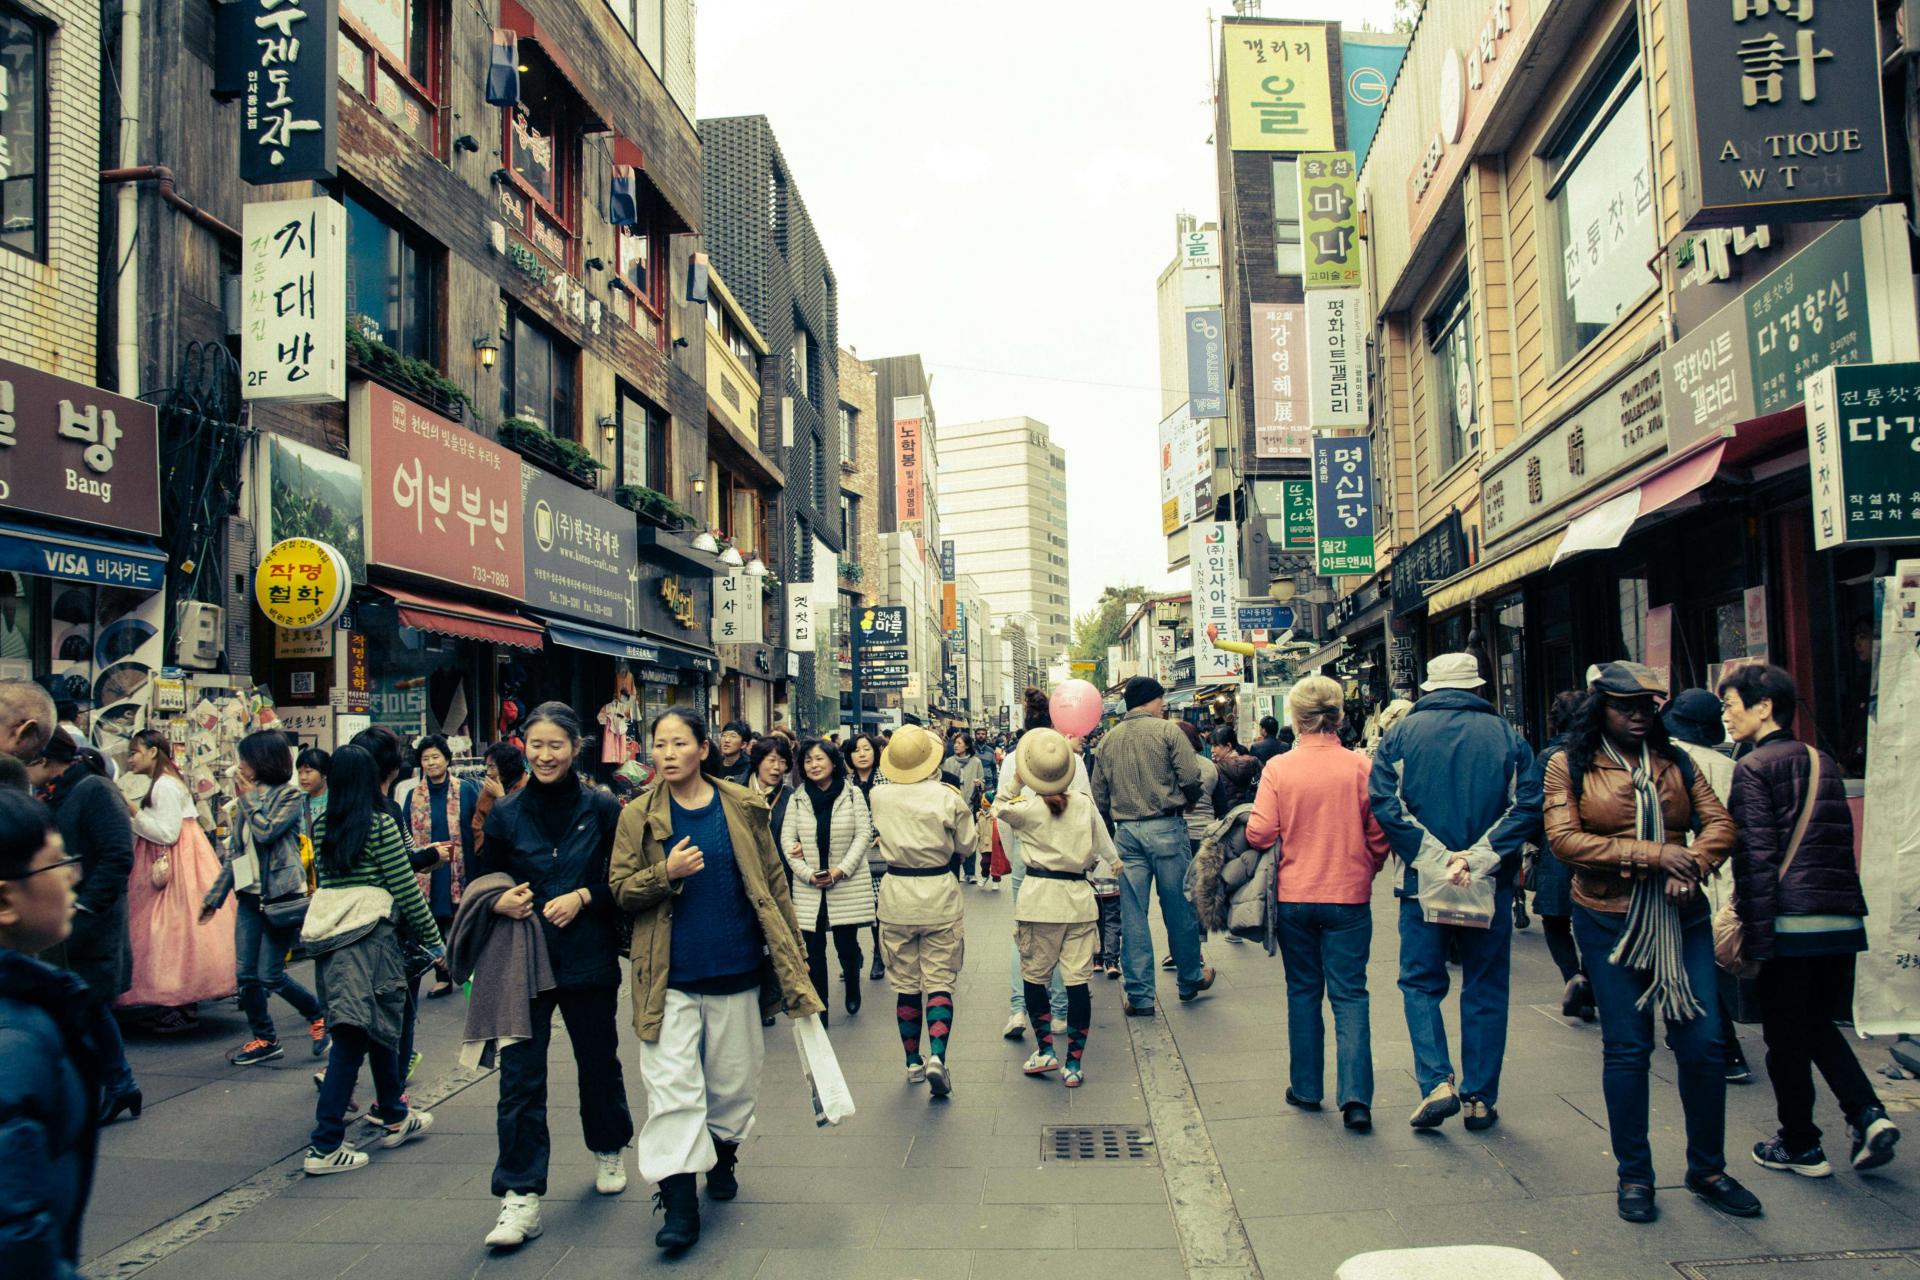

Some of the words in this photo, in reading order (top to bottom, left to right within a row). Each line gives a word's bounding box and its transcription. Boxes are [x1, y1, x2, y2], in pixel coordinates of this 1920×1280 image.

[1243, 38, 1312, 63] 갤러리
[1306, 160, 1348, 177] 옥션
[1313, 189, 1346, 257] 마니
[1566, 163, 1650, 290] 전통찻집
[1309, 269, 1340, 281] 고미술
[1343, 269, 1360, 280] 2F
[273, 211, 316, 382] 지대방
[1758, 272, 1849, 355] 다경향실
[1328, 300, 1348, 413] 평화아트갤러리
[1673, 330, 1734, 394] 평화아트
[248, 371, 268, 386] 2F
[1691, 369, 1738, 425] 갤러리
[58, 399, 123, 473] 방
[901, 426, 916, 467] 노학봉
[1318, 449, 1329, 484] 도서출판
[1812, 376, 1834, 538] 전통찻집
[65, 468, 112, 503] Bang
[1334, 446, 1368, 528] 명신당
[1850, 492, 1901, 505] 작설차
[1851, 508, 1902, 521] 모과차
[555, 510, 619, 558] (주)한국공예관
[1322, 540, 1346, 553] 월간
[42, 549, 90, 576] VISA
[96, 558, 152, 582] 비자카드
[270, 563, 322, 581] 작명
[472, 566, 510, 588] 733-7893
[1322, 555, 1372, 570] 아트앤씨
[268, 585, 324, 606] 철학
[721, 576, 738, 636] 인사동
[1206, 545, 1230, 668] (주)인사아트프자
[794, 595, 808, 640] 옛찻집
[875, 620, 903, 637] 마루
